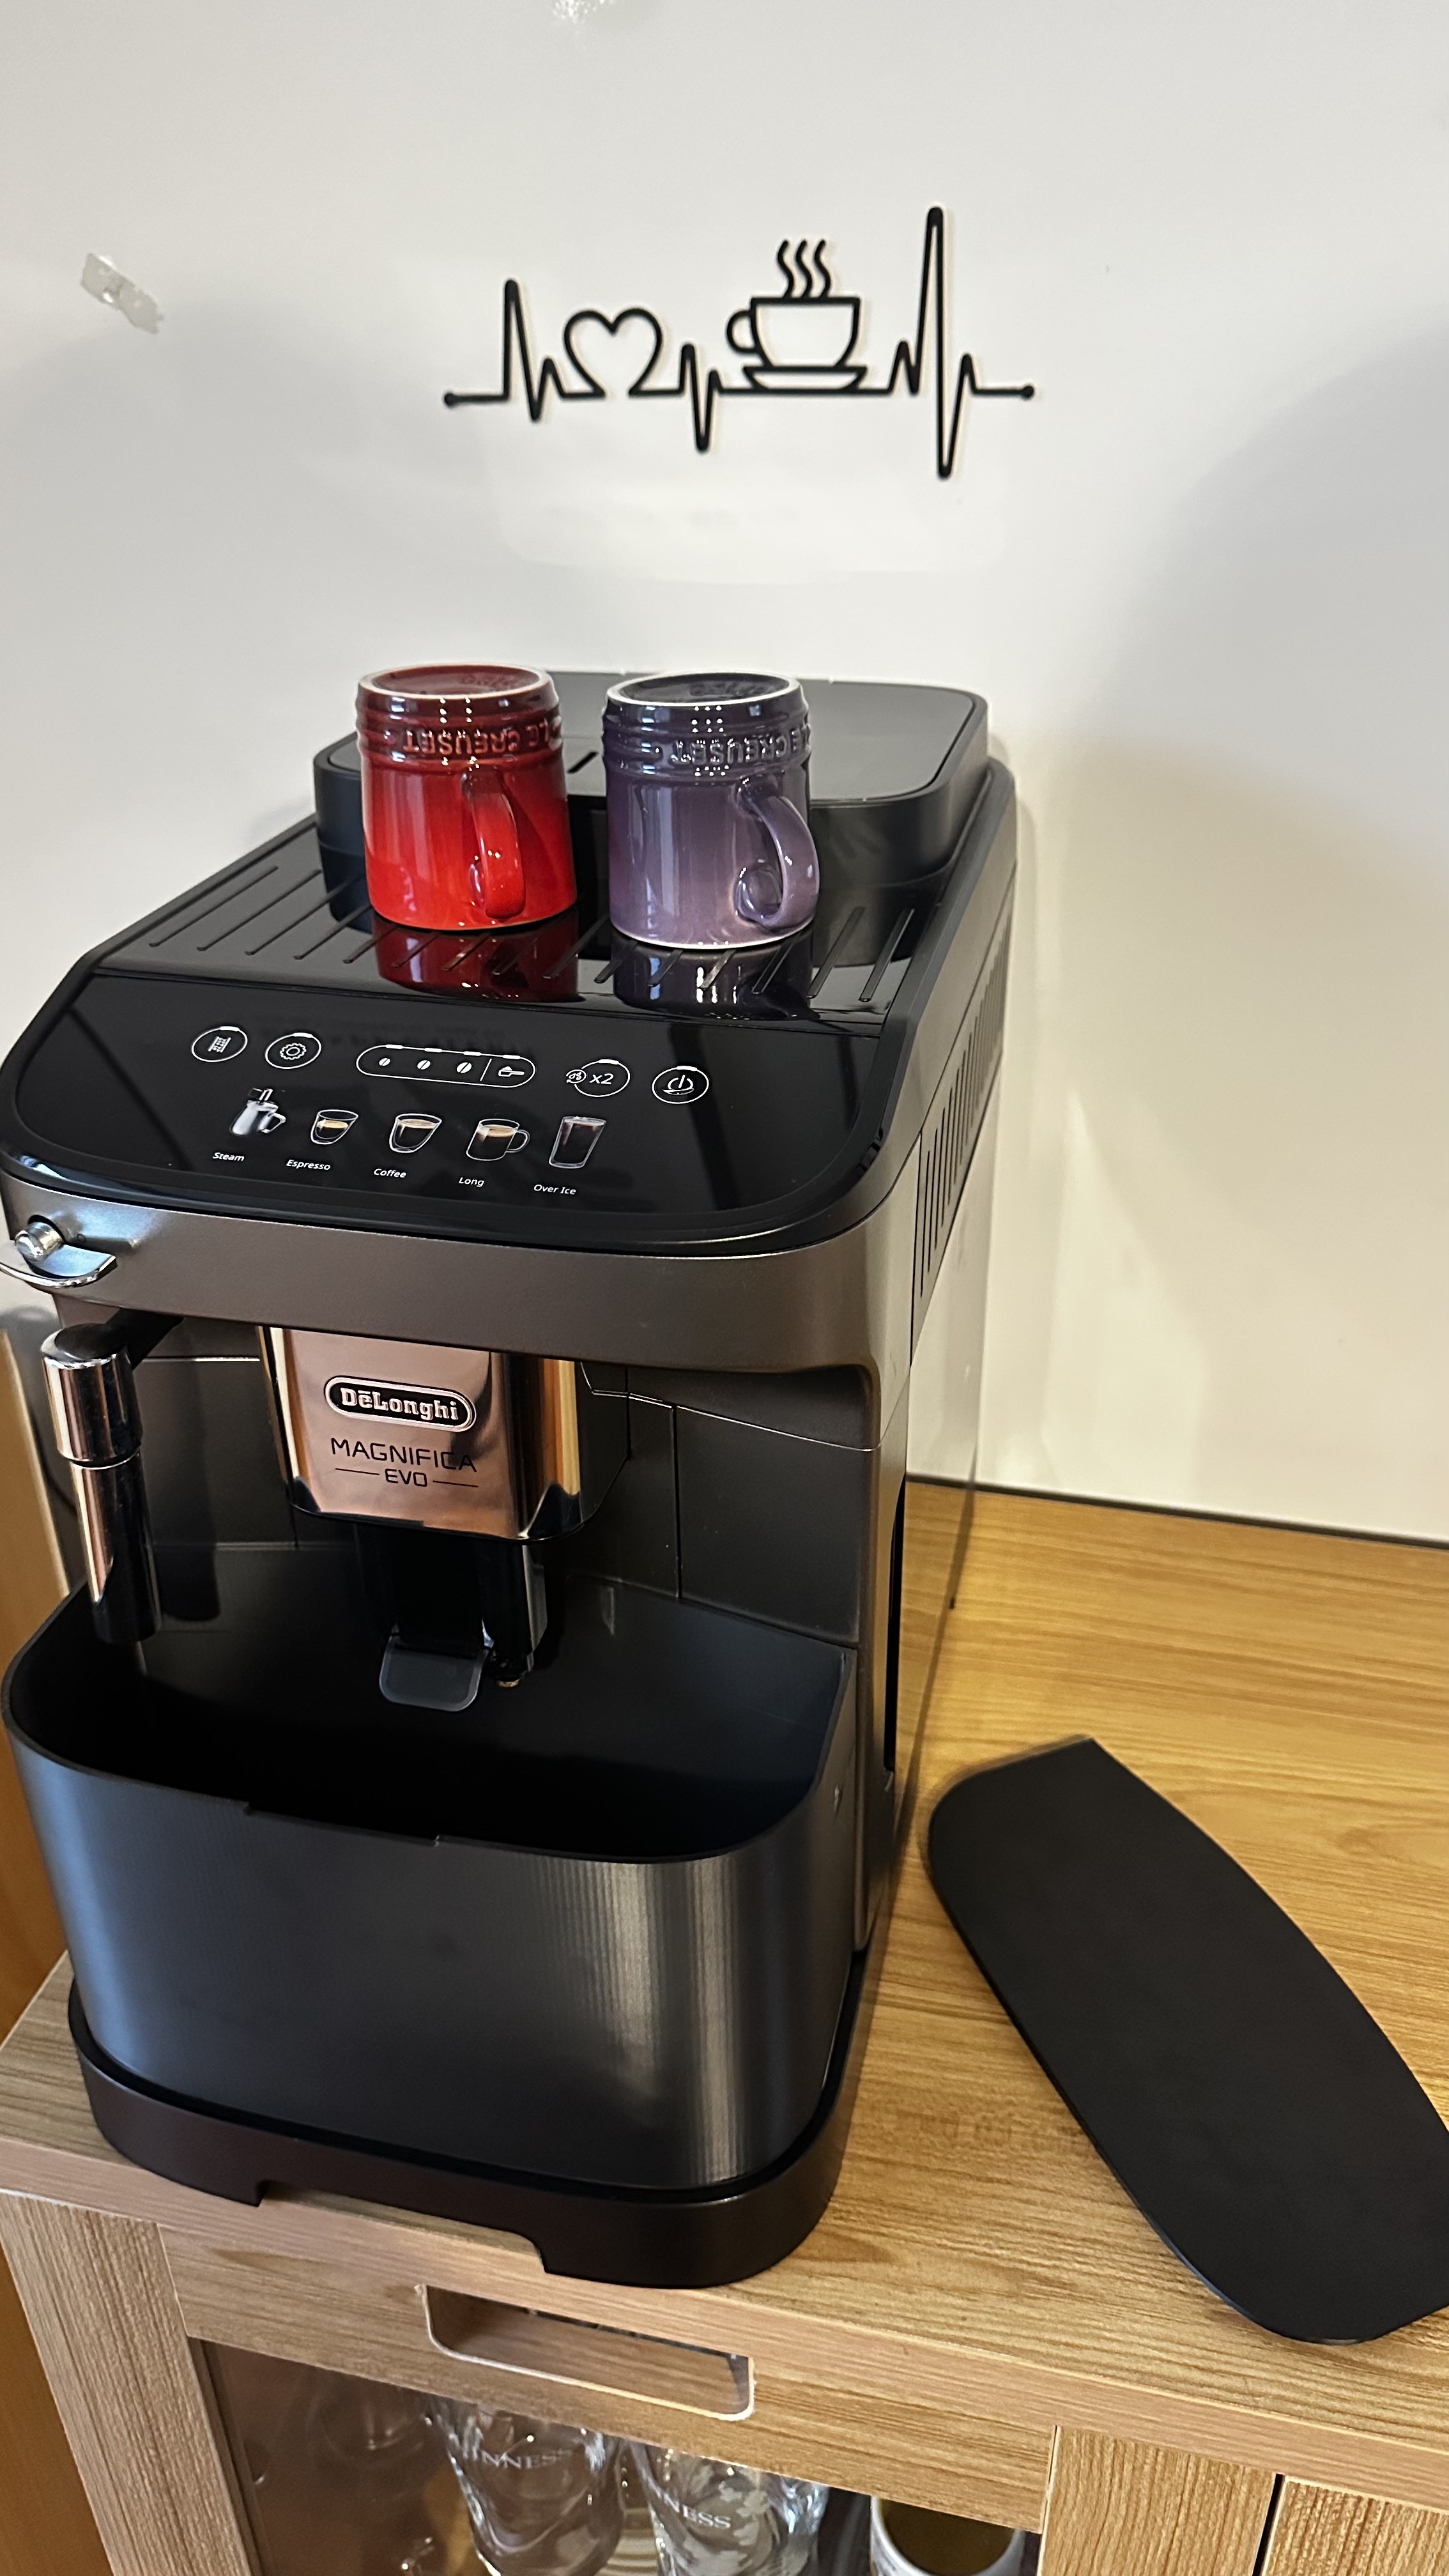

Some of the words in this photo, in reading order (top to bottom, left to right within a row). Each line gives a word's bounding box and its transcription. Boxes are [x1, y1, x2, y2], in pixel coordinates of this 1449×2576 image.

[402, 729, 521, 755] CREUSET
[668, 735, 787, 764] CREUSET
[213, 1153, 244, 1161] Steam
[286, 1160, 330, 1170] Espresso
[374, 1169, 406, 1177] Coffee
[459, 1177, 484, 1187] Long
[330, 1438, 477, 1473] MAGNIFICA
[384, 1468, 428, 1487] EVO
